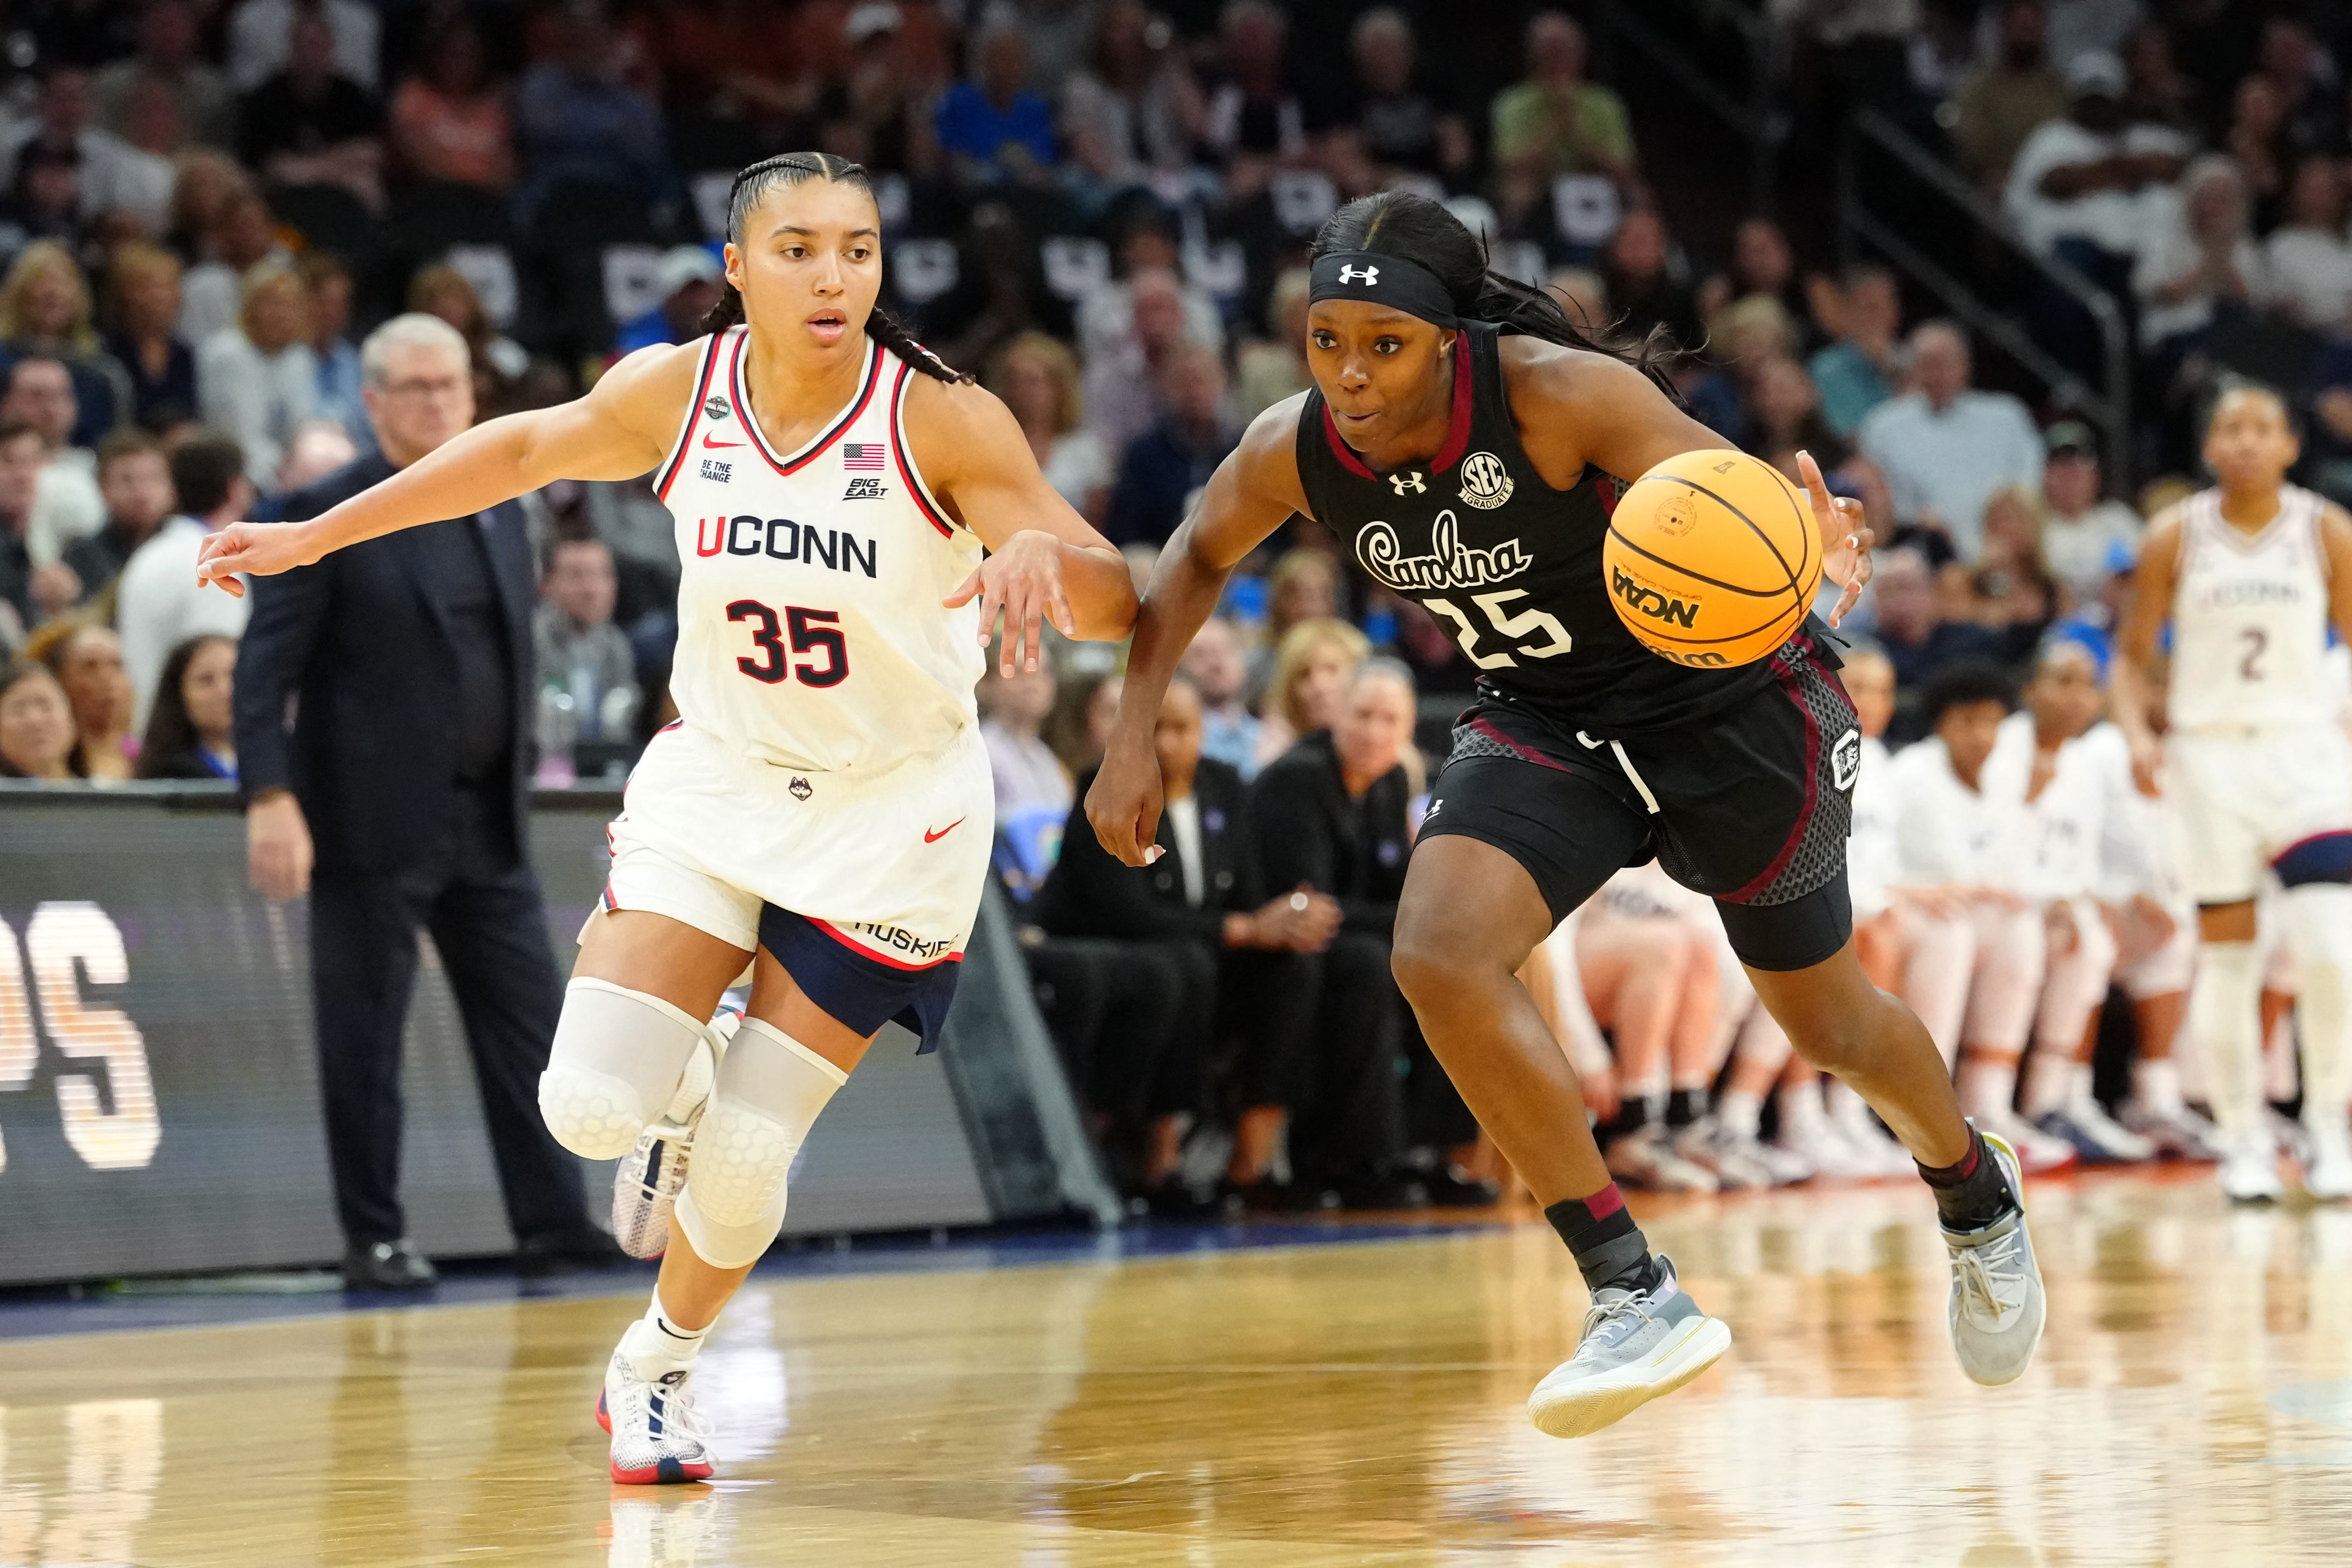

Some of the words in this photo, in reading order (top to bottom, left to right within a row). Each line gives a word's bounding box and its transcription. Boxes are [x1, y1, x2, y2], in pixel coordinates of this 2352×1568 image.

[702, 459, 712, 469] BE
[714, 462, 732, 473] THE
[850, 478, 881, 487] BIG
[1464, 455, 1502, 495] SEC
[845, 488, 889, 496] EAST
[1467, 488, 1512, 509] GRADUATE
[697, 515, 877, 579] UCONN
[1355, 509, 1534, 590] Carolina
[1613, 564, 1700, 629] NCAA
[1659, 585, 1702, 601] OFFICIAL
[726, 599, 849, 688] 35
[1422, 588, 1572, 669] 25
[2239, 626, 2269, 682] 2
